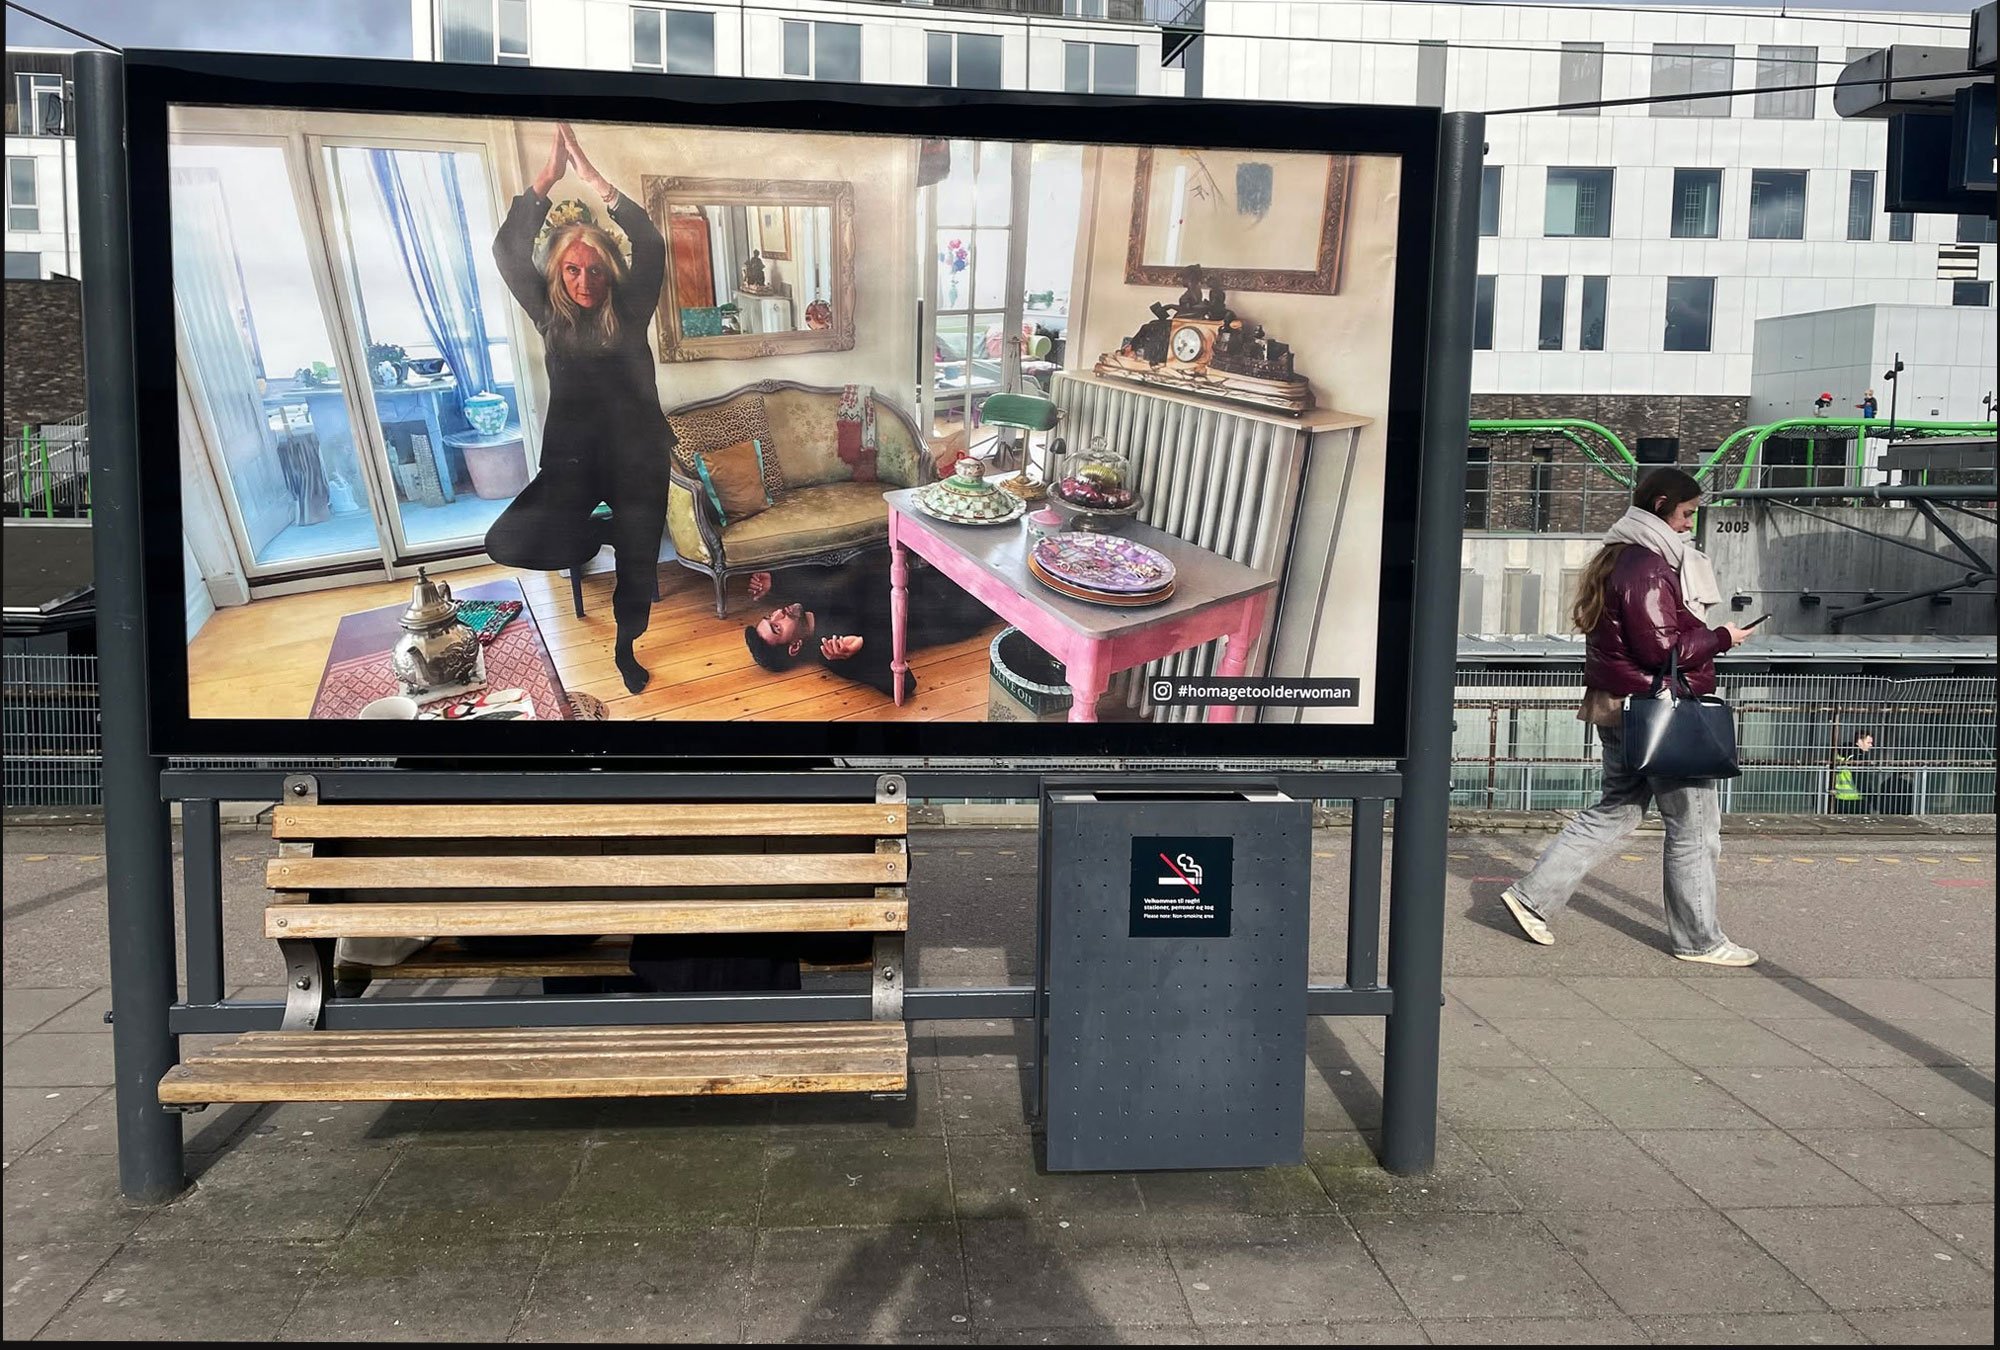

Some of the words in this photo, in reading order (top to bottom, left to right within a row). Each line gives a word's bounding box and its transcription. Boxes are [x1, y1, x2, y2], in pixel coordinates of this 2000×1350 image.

[1716, 521, 1750, 533] 2003
[1017, 688, 1035, 708] OIL
[1177, 685, 1351, 700] #homagetoolderwoman
